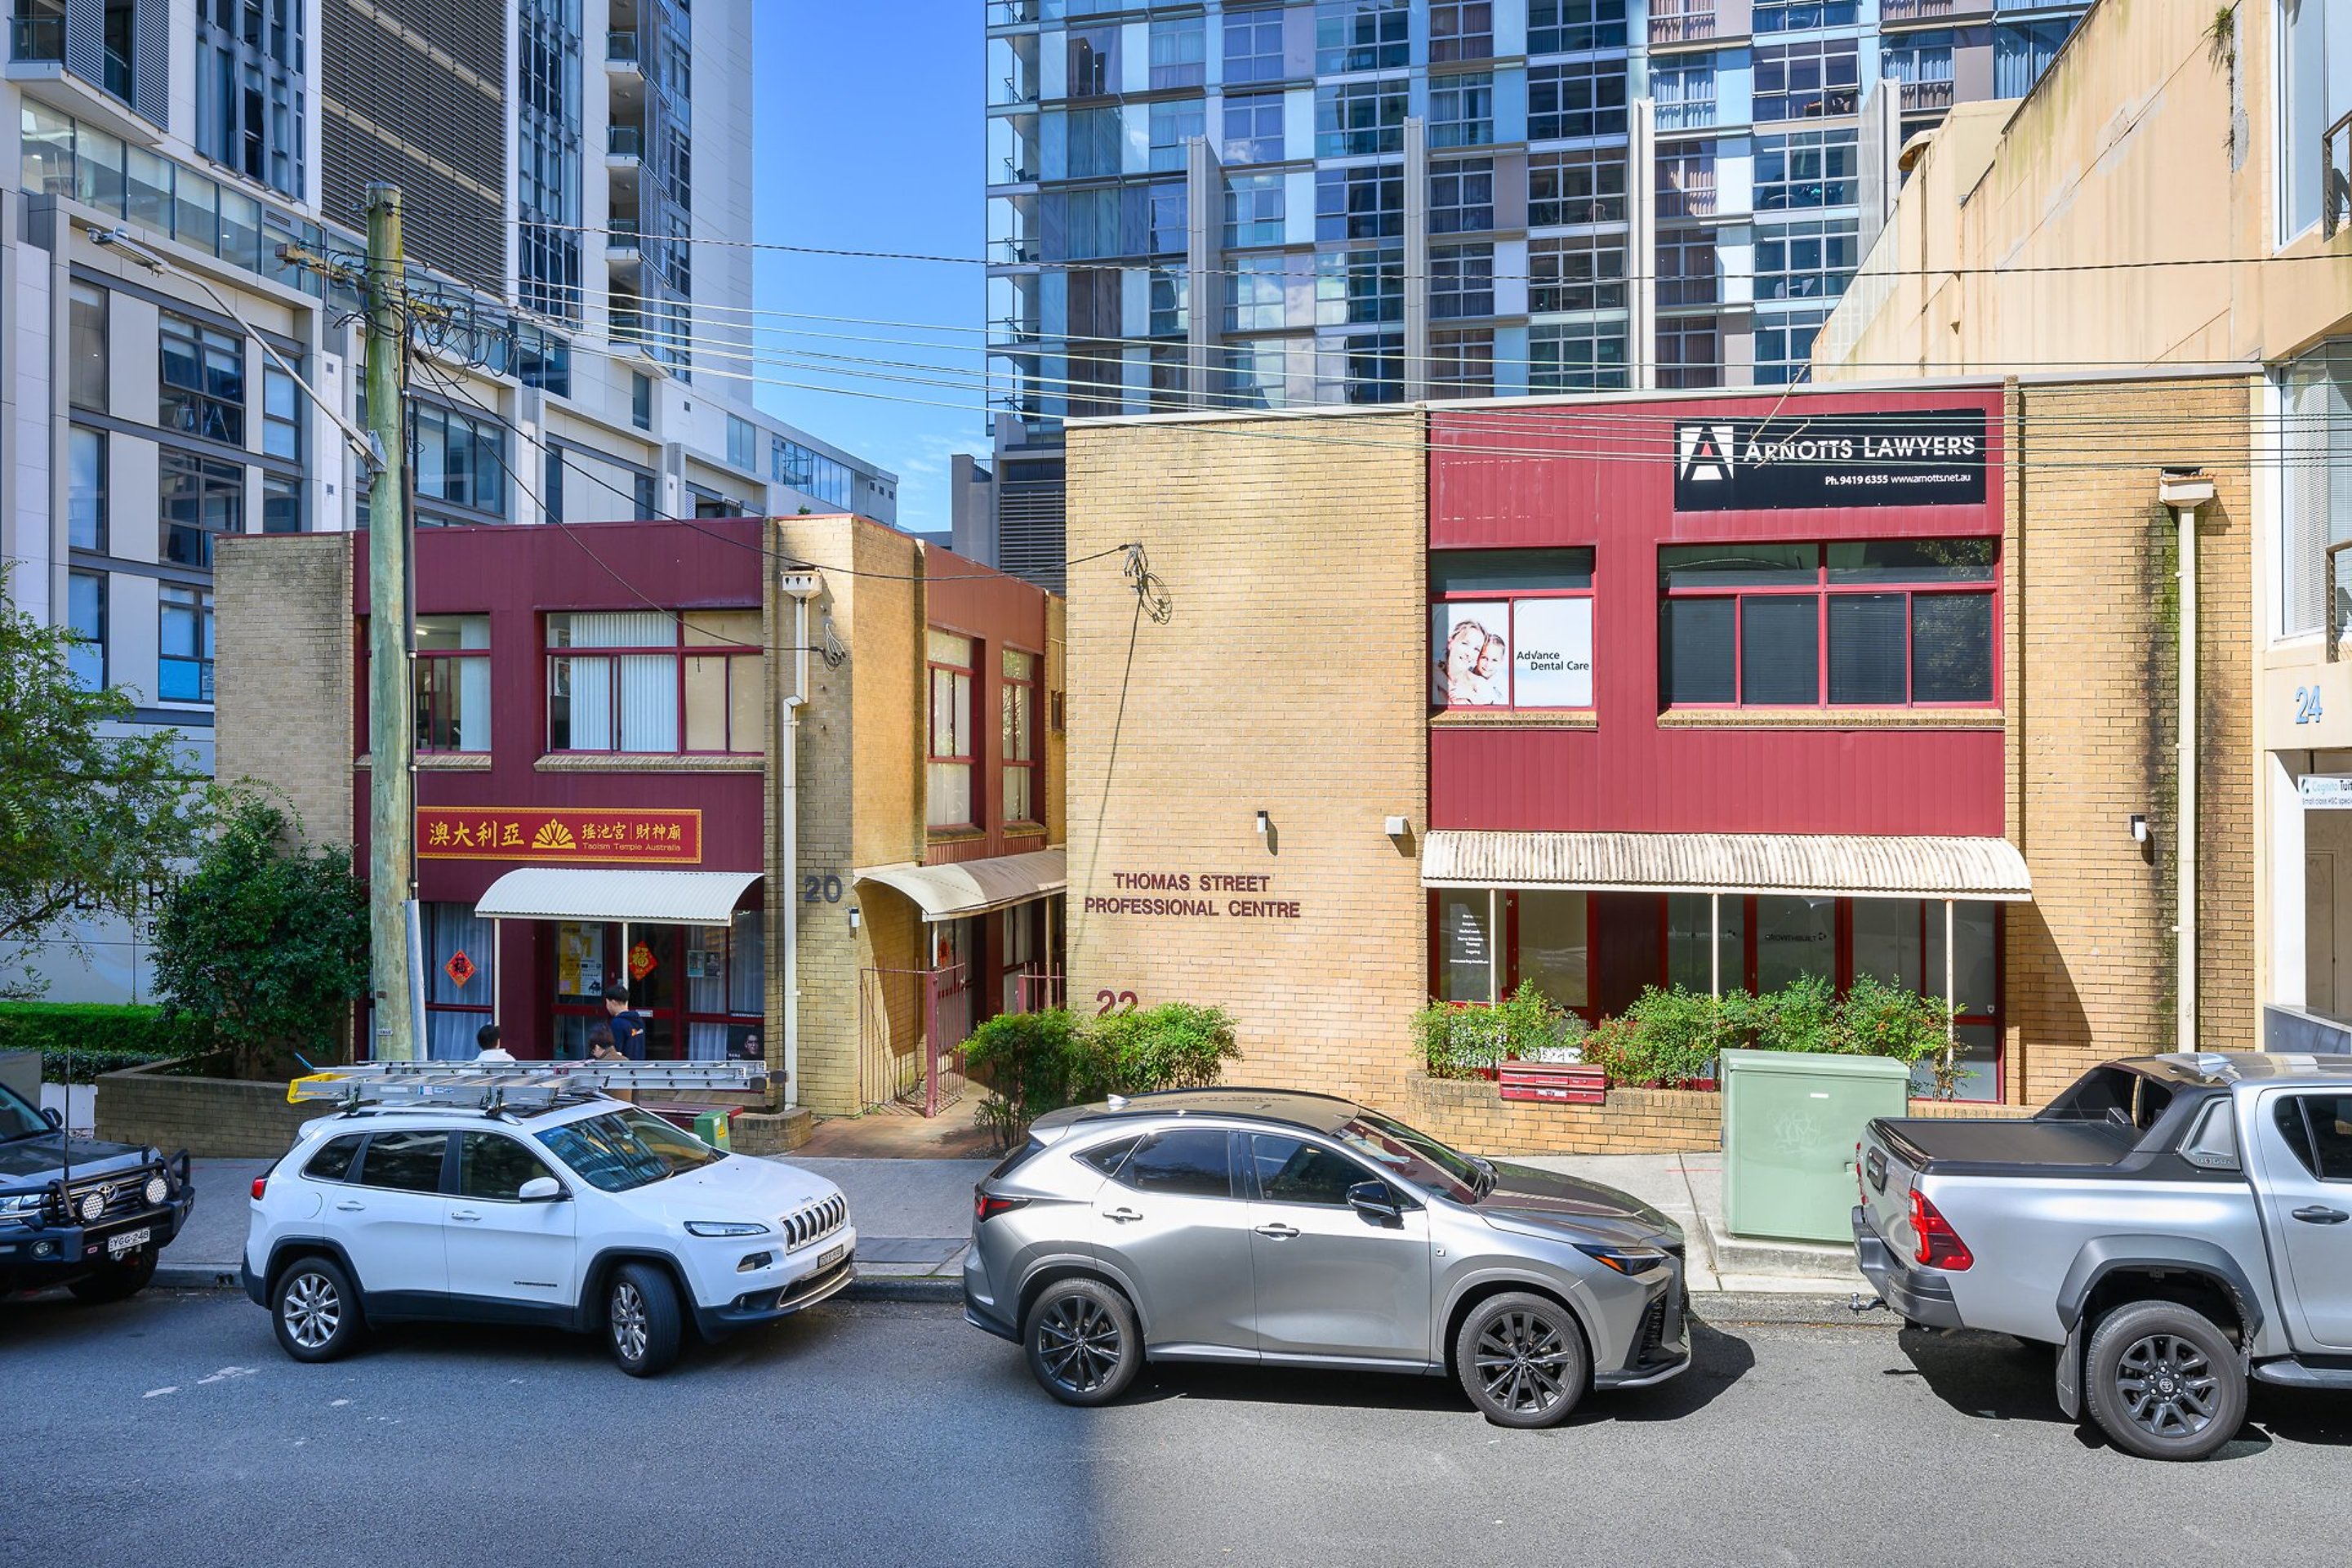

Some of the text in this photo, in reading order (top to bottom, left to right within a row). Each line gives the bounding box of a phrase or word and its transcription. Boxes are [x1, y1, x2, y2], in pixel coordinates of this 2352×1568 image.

[1743, 435, 1976, 462] ARNOTTS LAWYERS
[1839, 475, 1864, 485] 9419
[1864, 474, 1889, 484] 6355
[1517, 650, 1560, 660] Advance
[1530, 661, 1589, 670] Dental Care
[2296, 685, 2323, 724] 24
[429, 820, 525, 849] 澳大利亞
[803, 875, 843, 902] 20
[1113, 872, 1271, 892] THOMAS STREET
[1085, 898, 1301, 918] PROFESSIONAL CENTRE
